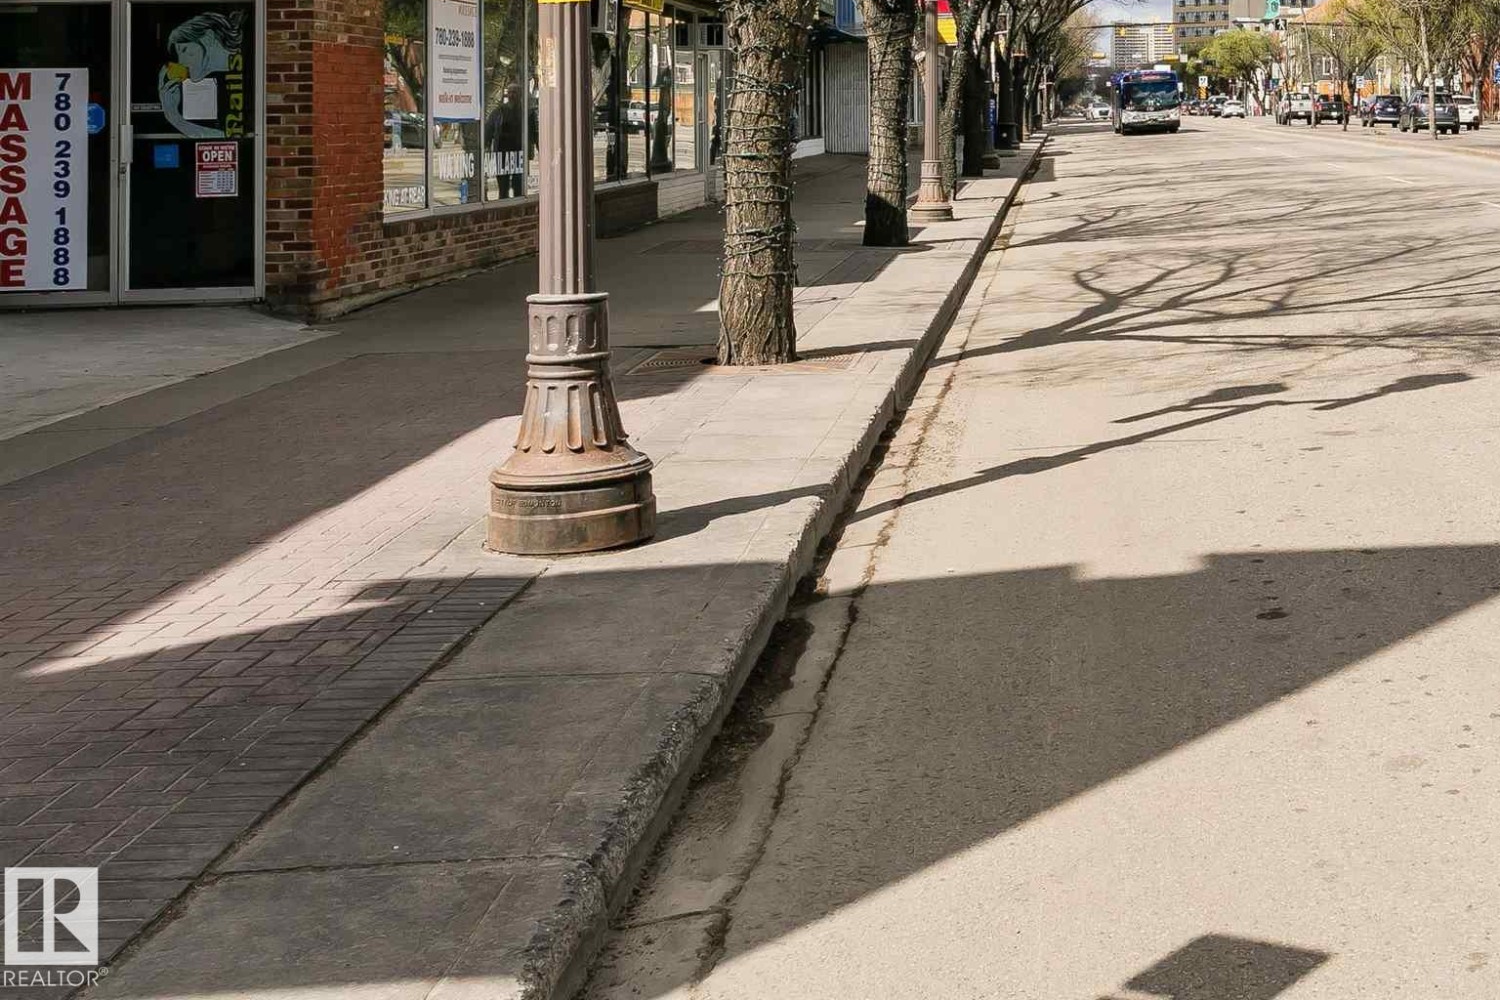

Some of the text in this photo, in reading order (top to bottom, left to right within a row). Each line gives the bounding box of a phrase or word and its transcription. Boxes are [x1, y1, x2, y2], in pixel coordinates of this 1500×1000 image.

[202, 150, 232, 162] OPEN
[438, 150, 524, 180] WAXING AVAILABLE
[0, 72, 31, 287] MASSAGE
